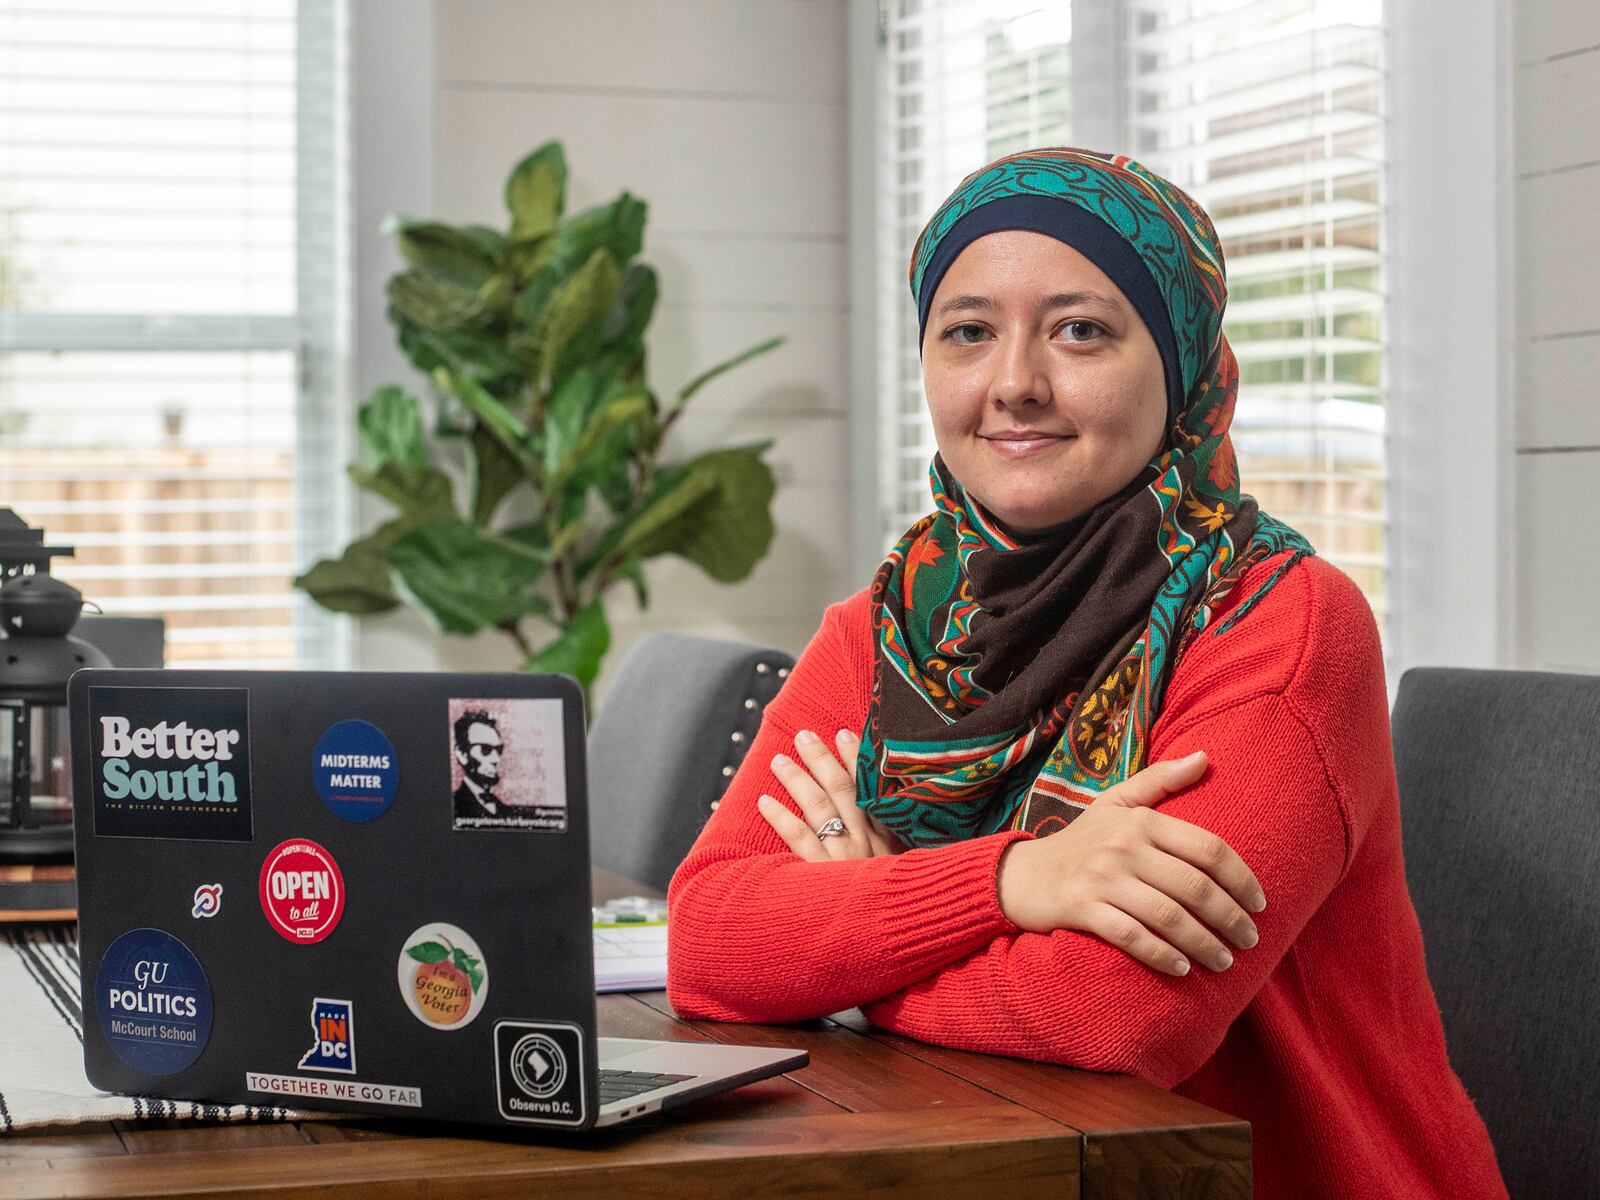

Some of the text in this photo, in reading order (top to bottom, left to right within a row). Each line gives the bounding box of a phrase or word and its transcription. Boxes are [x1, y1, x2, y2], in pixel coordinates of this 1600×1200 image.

[100, 716, 240, 760] Better
[320, 754, 391, 769] MIDTERMS
[102, 758, 238, 803] South
[330, 774, 382, 789] MATTER
[171, 805, 239, 813] SOUTHERNER
[271, 871, 330, 900] OPEN
[290, 901, 320, 920] to all
[134, 960, 169, 990] GU
[415, 975, 468, 999] Georgia
[109, 988, 197, 1017] POLITICS
[421, 992, 460, 1013] Voter
[320, 1012, 345, 1020] MADE
[111, 1020, 196, 1042] McCourt School
[320, 1018, 347, 1043] IN
[321, 1041, 347, 1059] DC
[250, 1076, 418, 1104] TOGETHER WE GO FAR
[509, 1098, 574, 1115] Observe D.C.
